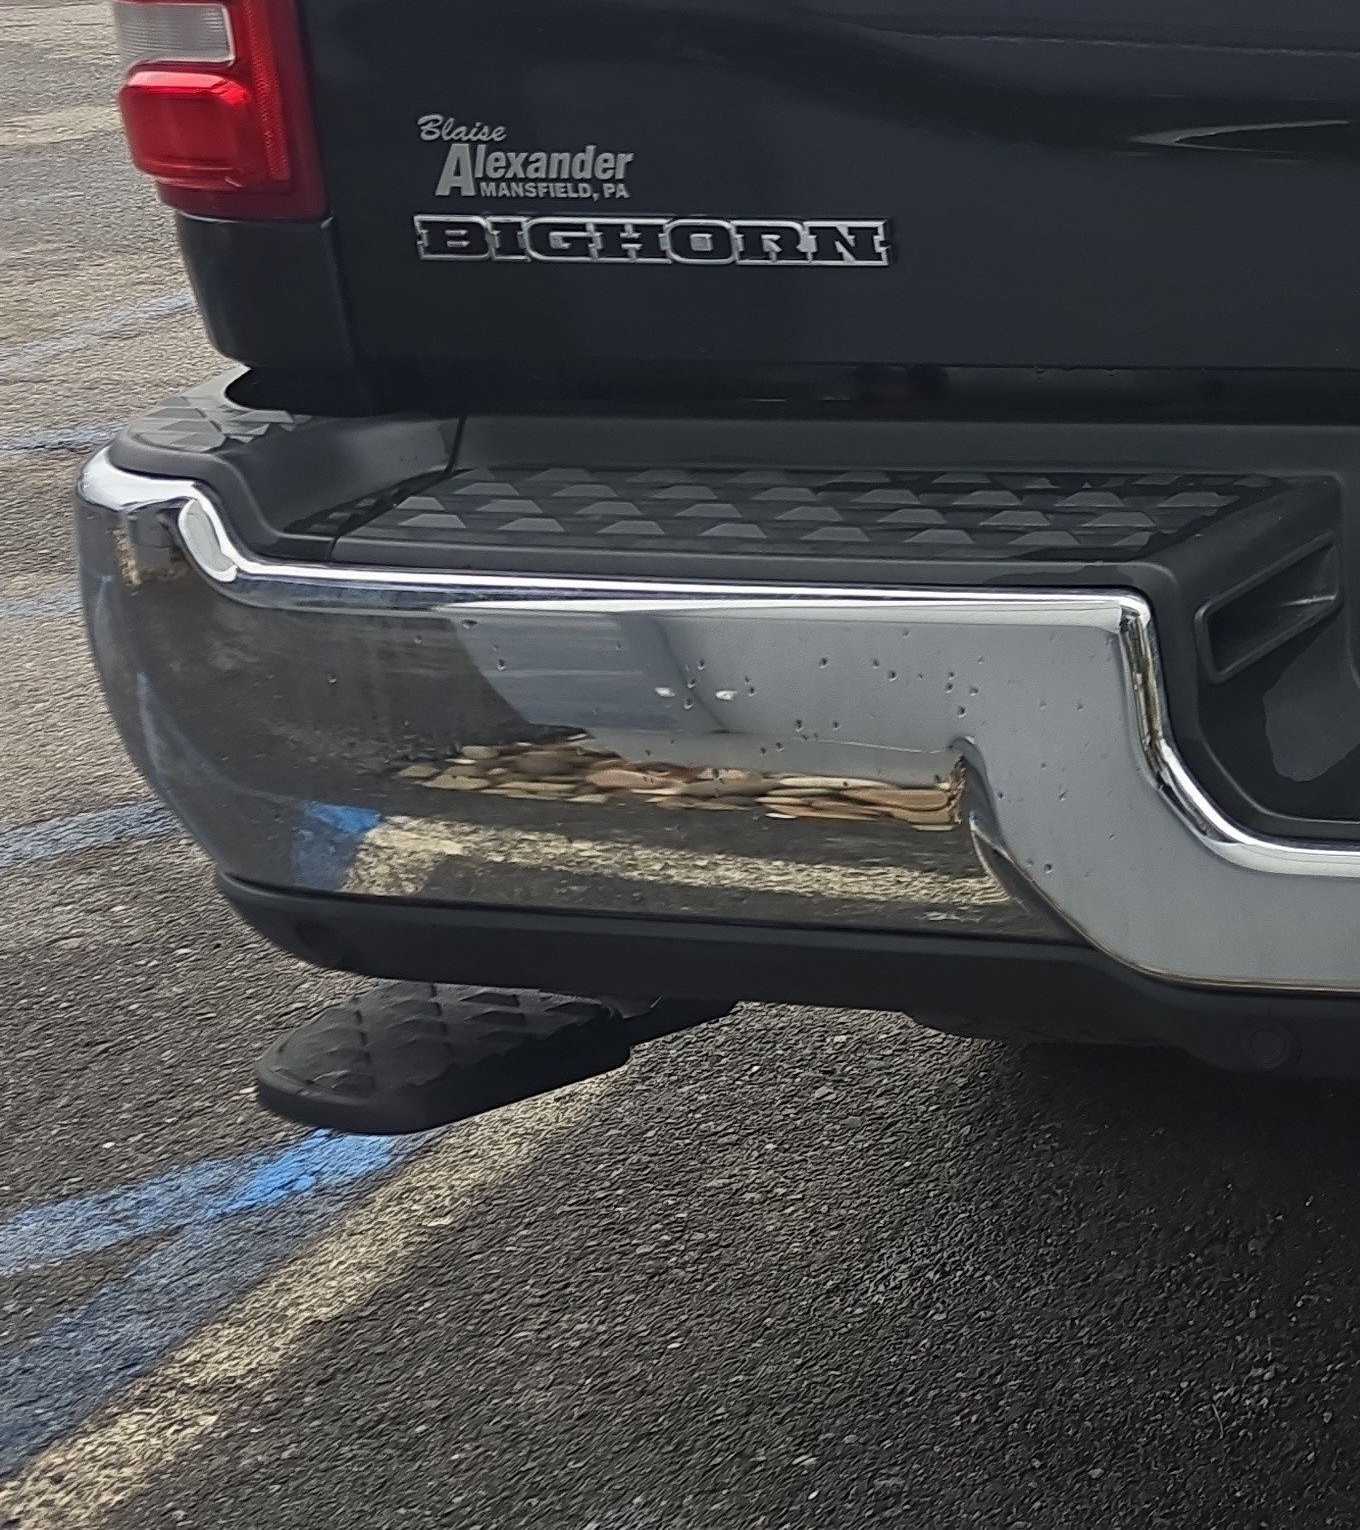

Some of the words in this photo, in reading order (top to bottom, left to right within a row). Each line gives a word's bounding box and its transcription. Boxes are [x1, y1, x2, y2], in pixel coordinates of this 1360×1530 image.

[417, 113, 507, 142] Blaise
[435, 143, 634, 197] Alexander
[480, 182, 600, 202] MANSFIELD,
[603, 183, 630, 200] PA
[413, 215, 891, 267] BIGHORN
